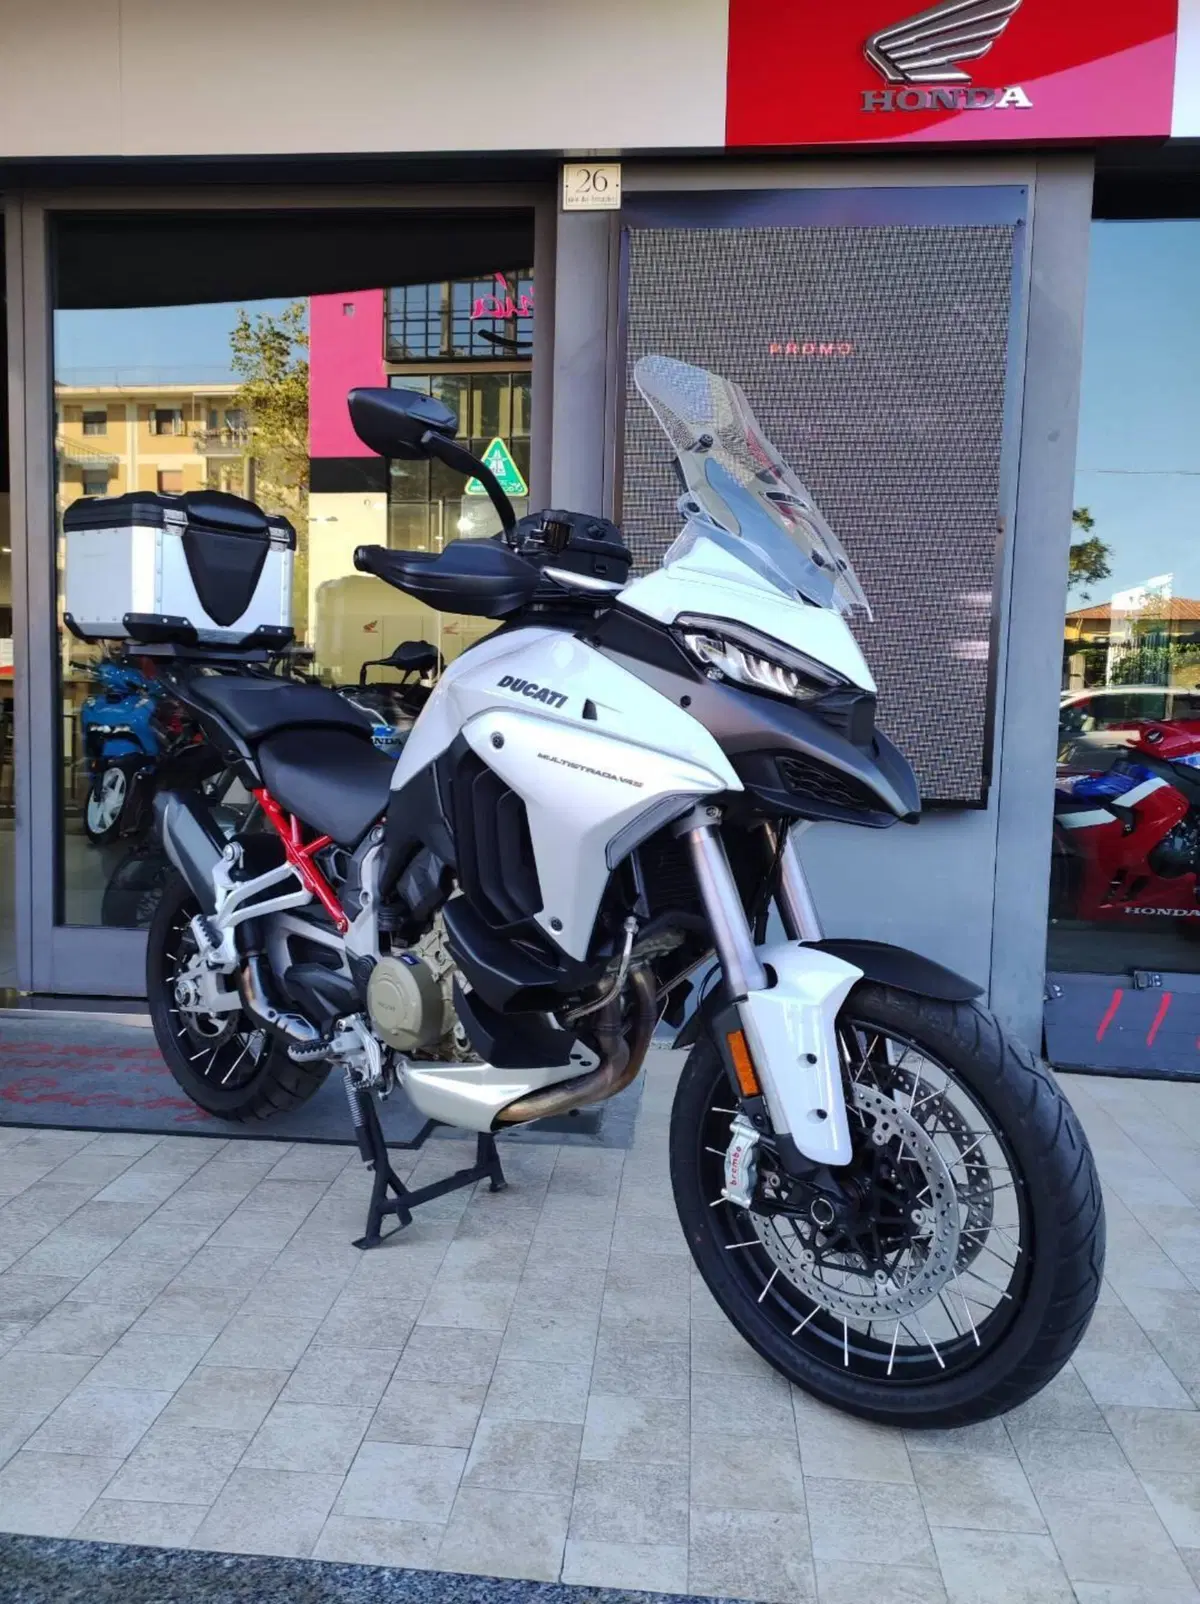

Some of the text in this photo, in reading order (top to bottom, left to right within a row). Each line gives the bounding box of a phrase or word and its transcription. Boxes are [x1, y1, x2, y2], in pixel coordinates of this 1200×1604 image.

[860, 86, 1033, 112] HONDA
[575, 168, 608, 192] 26
[768, 342, 852, 356] PROMO
[497, 675, 568, 709] DUCATI
[537, 752, 618, 781] MULTISTRADA
[1124, 906, 1200, 917] HONDA
[729, 1146, 742, 1186] brembo
